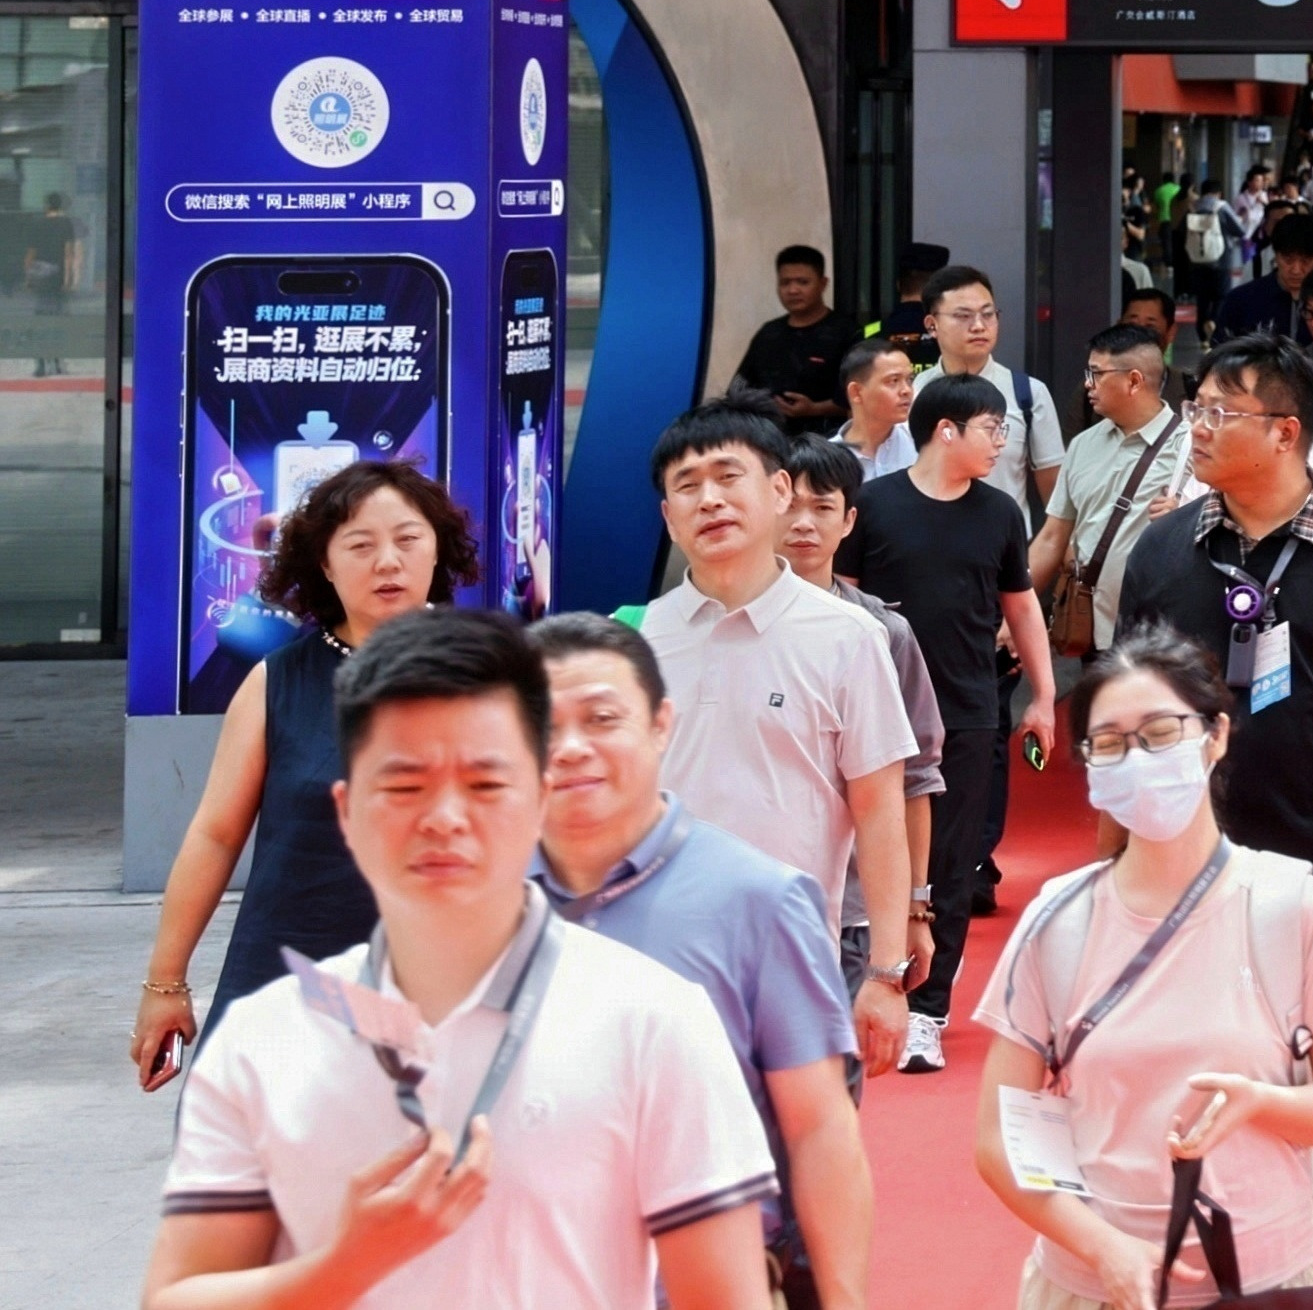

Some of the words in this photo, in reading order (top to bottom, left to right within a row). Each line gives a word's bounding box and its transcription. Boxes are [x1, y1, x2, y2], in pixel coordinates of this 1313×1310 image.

[178, 9, 234, 23] 全球参展
[255, 9, 311, 23] 全球直播
[332, 9, 388, 23] 全球发布
[409, 9, 464, 23] 全球贸易
[255, 304, 387, 322] 我的光亚展足迹
